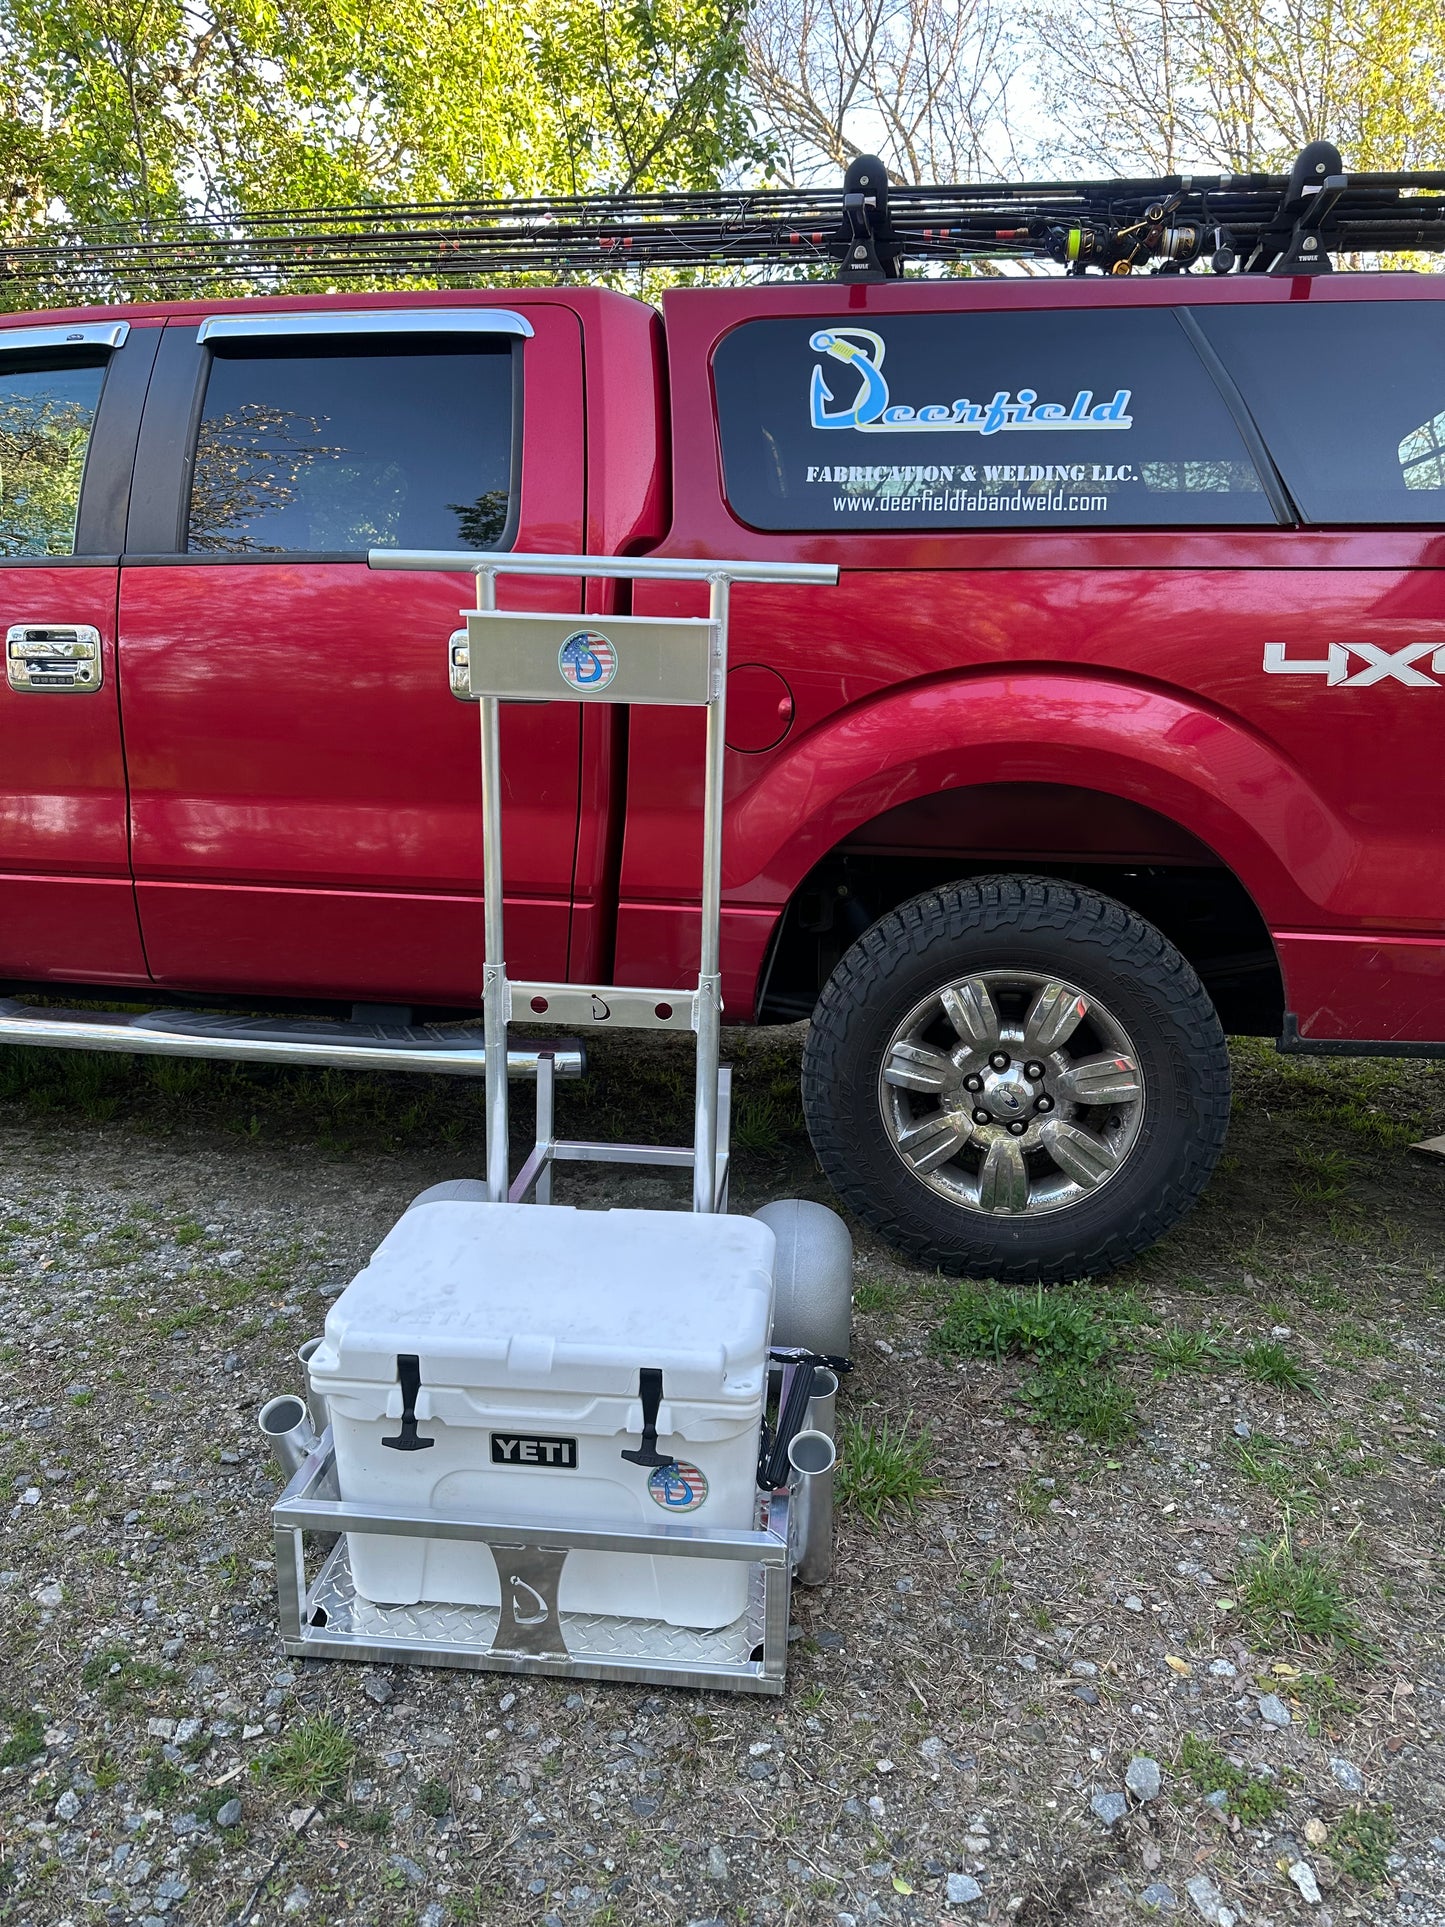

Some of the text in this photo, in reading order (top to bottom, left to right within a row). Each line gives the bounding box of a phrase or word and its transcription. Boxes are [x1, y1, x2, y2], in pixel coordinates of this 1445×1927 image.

[809, 327, 1133, 435] Deerfield
[806, 464, 1138, 482] FABRICATION & WELDING LLC.
[833, 489, 1107, 512] www.deerfieldfabandweld.com
[1262, 643, 1445, 687] 4X
[495, 1439, 570, 1463] YETI
